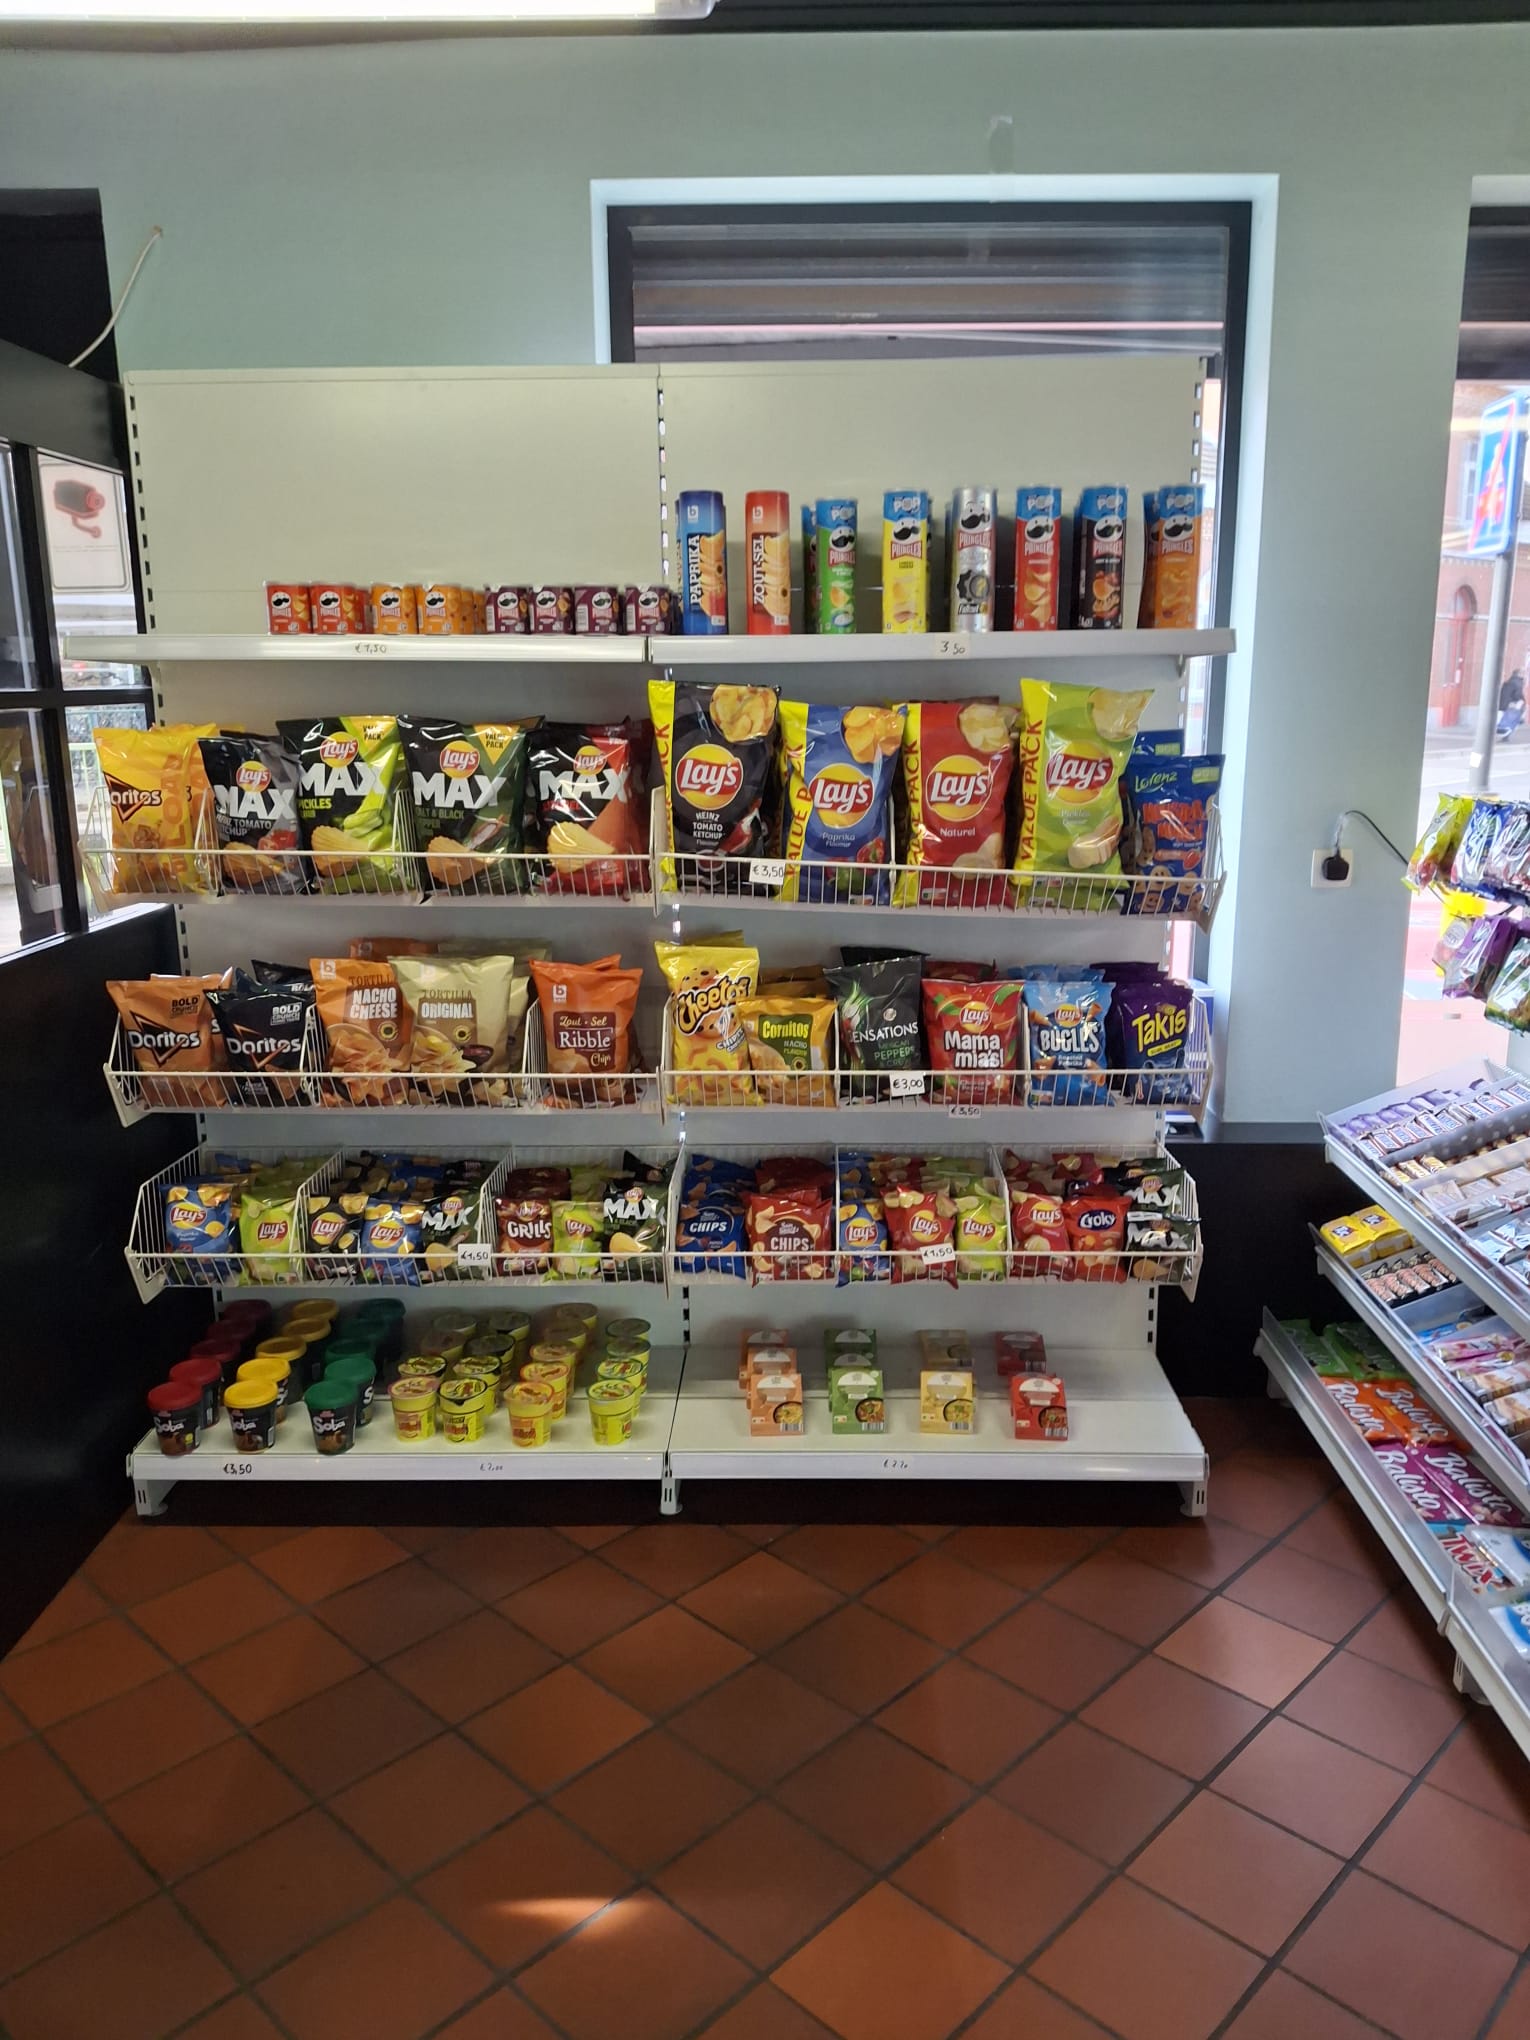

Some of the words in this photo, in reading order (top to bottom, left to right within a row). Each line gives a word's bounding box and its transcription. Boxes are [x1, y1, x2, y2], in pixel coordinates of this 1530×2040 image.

[892, 541, 922, 558] PRINGLES
[959, 532, 991, 549] PRINGLES
[688, 534, 702, 605] PAPRIKA
[323, 741, 357, 761] Lay's
[486, 740, 504, 749] PACK
[1024, 719, 1043, 785] PACK
[443, 750, 478, 770] Lay's
[240, 769, 269, 787] Lay's
[299, 762, 387, 796] MAX
[680, 759, 739, 796] Lay's
[904, 740, 920, 804] PACK
[1050, 752, 1111, 790] Lay's
[412, 771, 507, 809] MAX
[539, 768, 630, 804] MAX
[931, 772, 989, 807] Lay's
[1135, 771, 1178, 793] Lorenz
[110, 789, 162, 806] oritos
[213, 784, 297, 820] MAX
[814, 778, 870, 814] Lay's
[234, 819, 272, 830] TOMATO
[695, 812, 721, 822] HEINZ
[1020, 791, 1037, 861] VALUE
[692, 822, 724, 832] TOMATO
[693, 831, 724, 839] KETCHUP
[940, 827, 976, 837] Naturel
[785, 810, 808, 877] VALUE
[822, 832, 856, 842] Paprika
[172, 996, 199, 1007] BOLD
[352, 987, 397, 1004] NACHO
[272, 1004, 300, 1015] BOLD
[350, 1002, 398, 1020] CHEESE
[421, 1002, 474, 1019] ORIGINAL
[962, 1008, 990, 1025] Lay's
[762, 1020, 809, 1038] Cornitos
[1040, 1021, 1100, 1053] BUGLES
[1132, 1009, 1187, 1053] Takis
[128, 1031, 201, 1048] Doritos
[226, 1037, 301, 1054] Doritos
[559, 1031, 612, 1048] Ribble
[784, 1040, 807, 1049] NACHO
[945, 1030, 1001, 1051] Mama
[172, 1207, 207, 1225] Lay's
[604, 1198, 659, 1220] MAX
[1032, 1210, 1061, 1223] Lay's
[422, 1206, 474, 1231] MAX
[690, 1221, 728, 1233] CHIPS
[912, 1217, 940, 1235] Lay's
[965, 1219, 994, 1236] Lay's
[1080, 1211, 1116, 1228] Croky
[259, 1222, 287, 1239] Lay's
[371, 1226, 403, 1241] Lay's
[507, 1219, 553, 1239] GRILLS
[849, 1225, 876, 1241] Lay's
[770, 1237, 810, 1251] CHIPS
[154, 1416, 185, 1434] Soba
[313, 1416, 346, 1433] Soba
[1375, 1450, 1440, 1510] Balisto
[1425, 1452, 1512, 1513] Balisto
